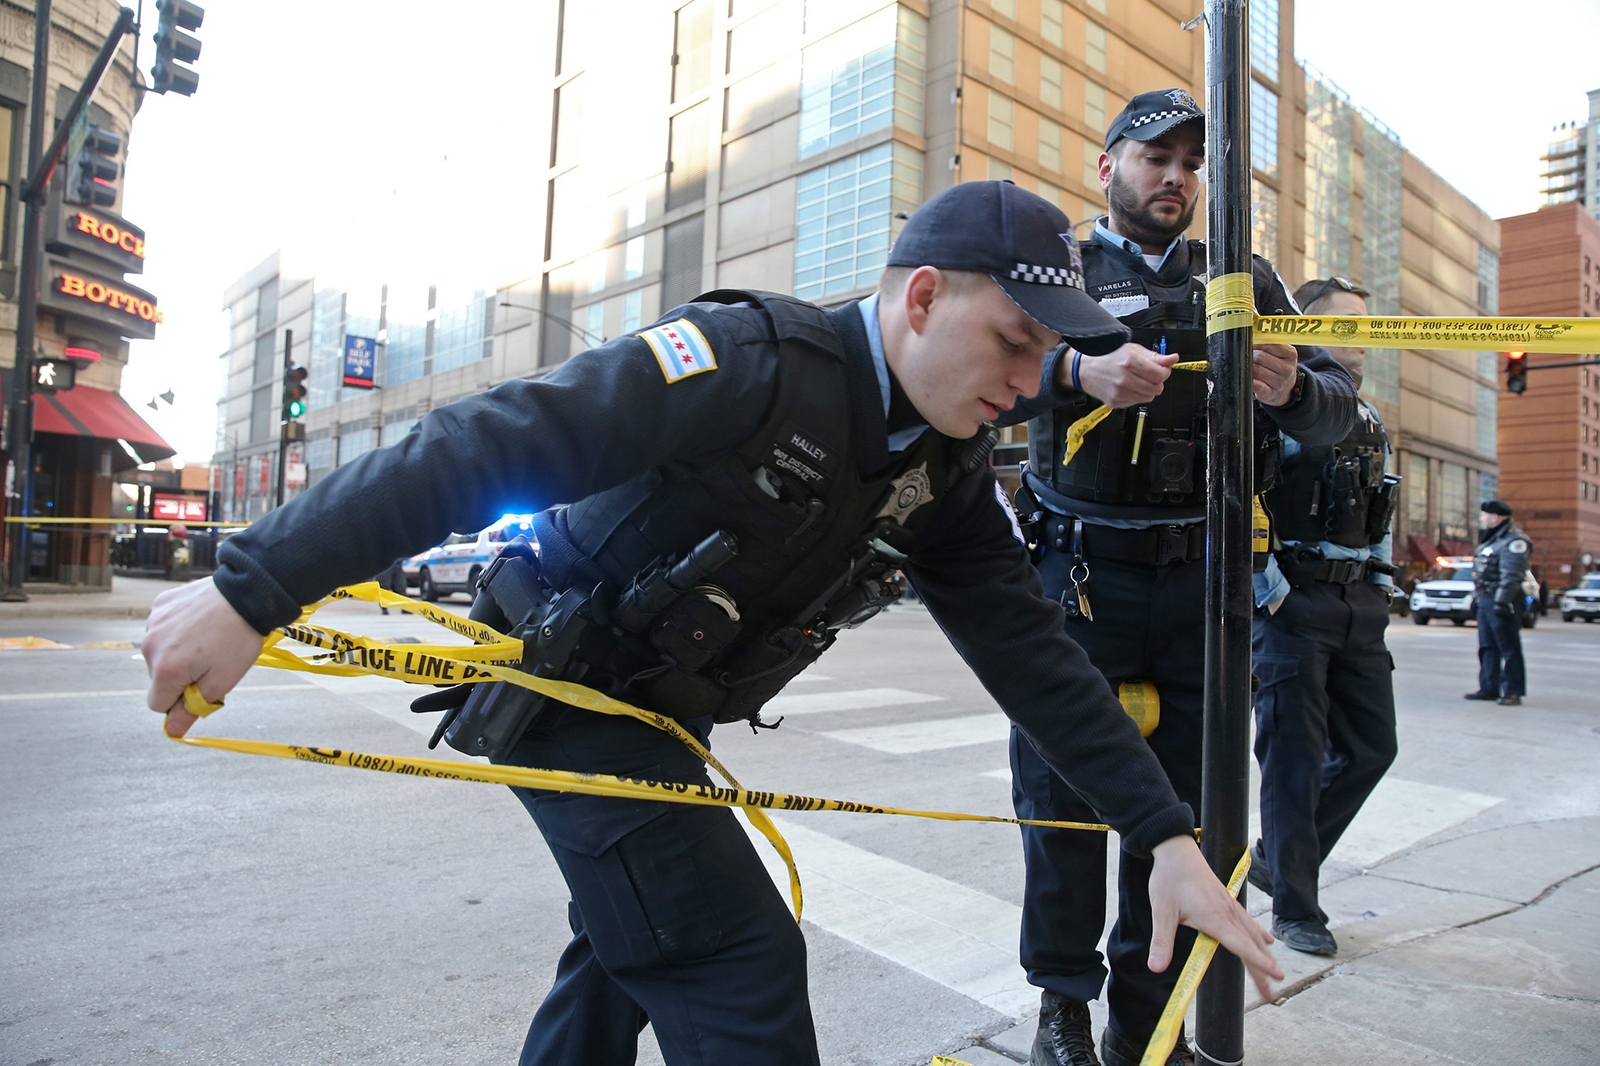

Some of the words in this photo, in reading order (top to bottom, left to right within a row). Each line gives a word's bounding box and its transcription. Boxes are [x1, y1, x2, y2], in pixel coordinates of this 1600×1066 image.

[1097, 280, 1132, 292] VARELAS
[790, 433, 827, 462] HALLEY
[788, 457, 824, 481] DISTRICT
[404, 651, 455, 680] LINE
[348, 752, 395, 771] (7867)
